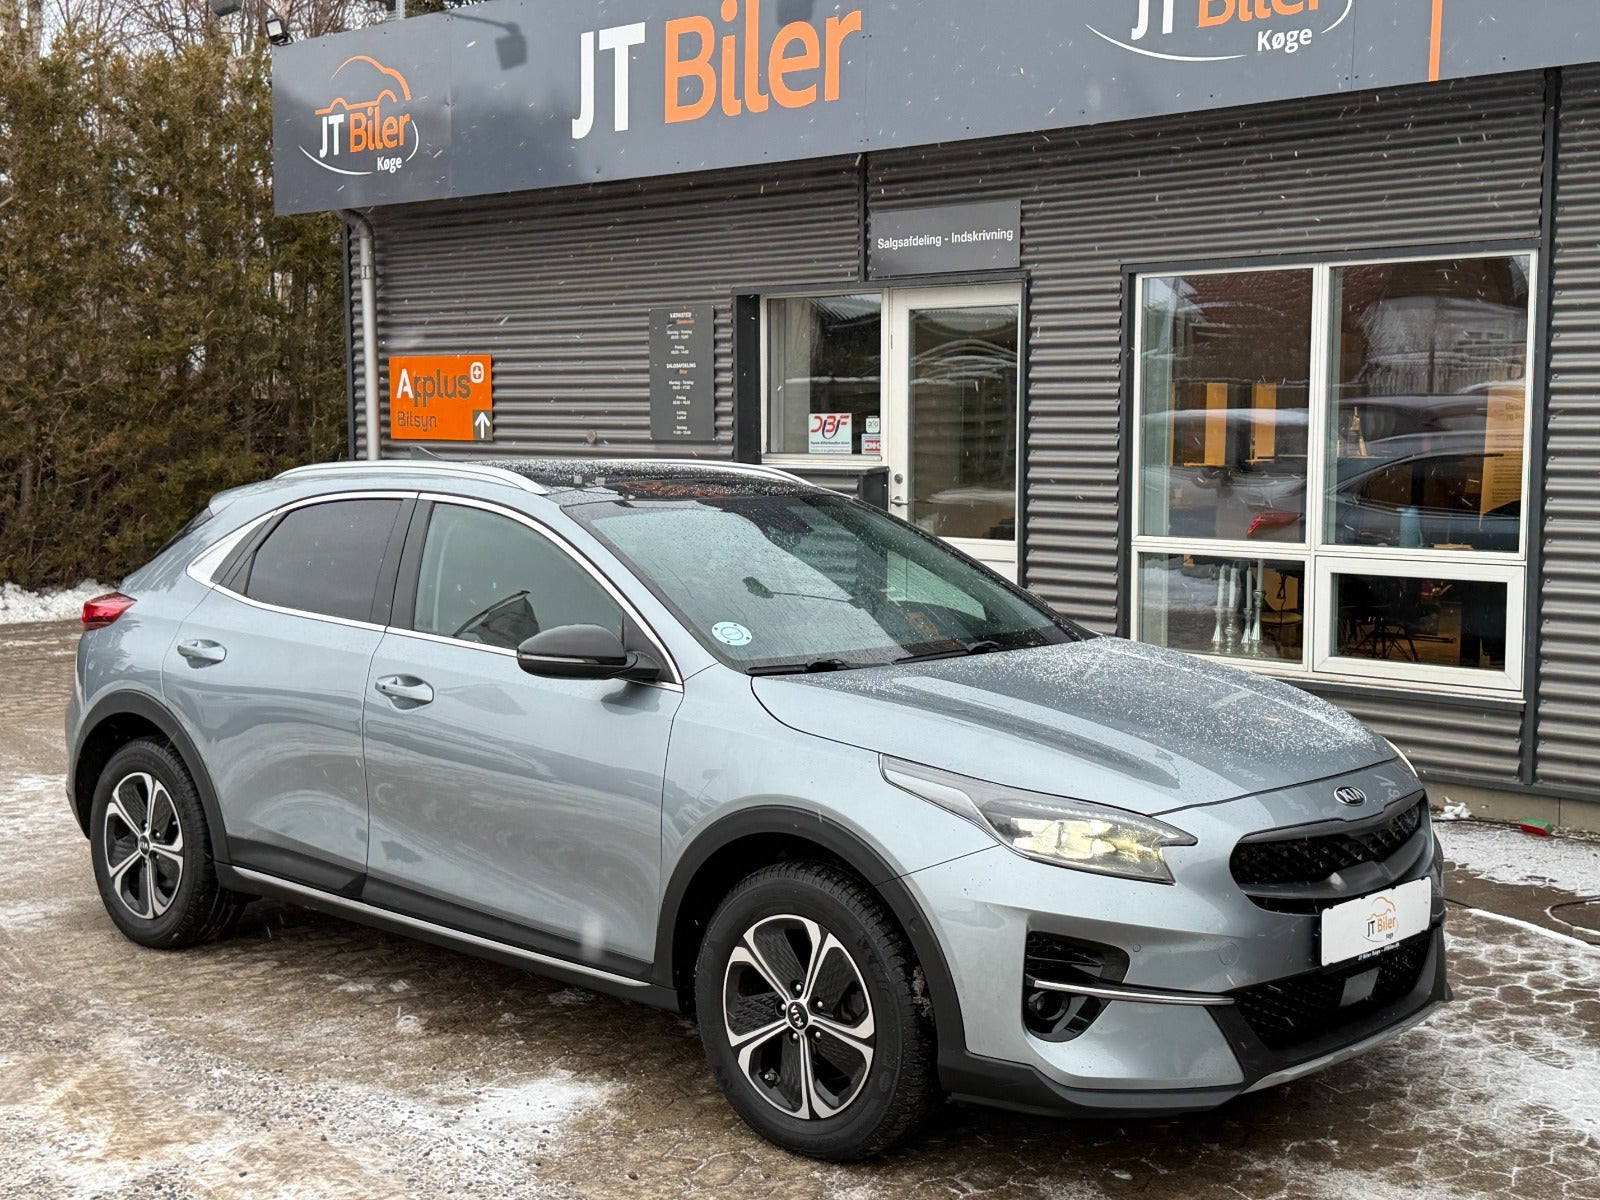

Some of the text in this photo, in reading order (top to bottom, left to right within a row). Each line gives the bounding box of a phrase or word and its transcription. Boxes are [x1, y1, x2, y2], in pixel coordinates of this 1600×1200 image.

[1257, 28, 1313, 54] Køge
[571, 0, 862, 140] JT Biler
[319, 106, 411, 158] JT Biler
[376, 156, 403, 174] Køge
[877, 234, 942, 250] Salgsafdeling
[951, 228, 1014, 244] Indskrivning
[397, 411, 437, 432] Bilsyn
[1377, 915, 1396, 933] Biler
